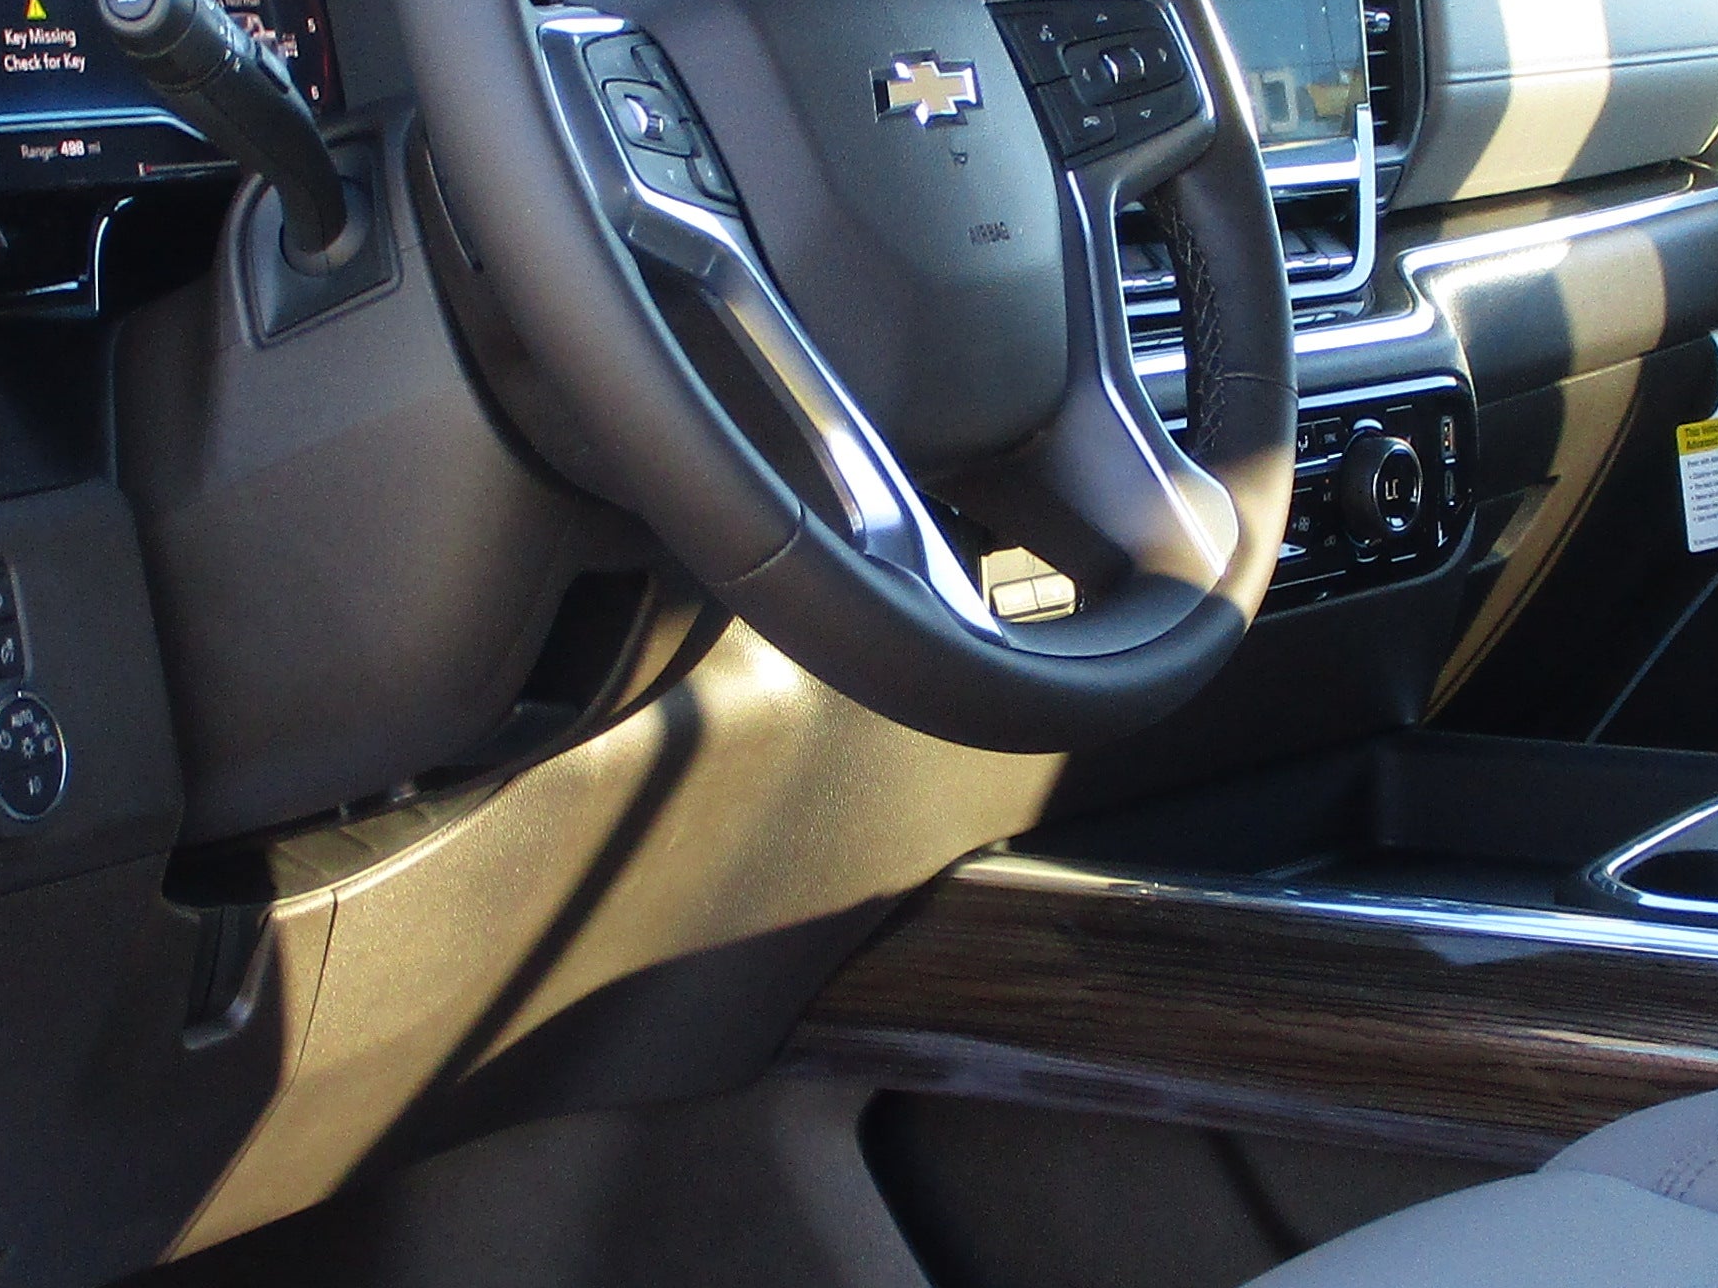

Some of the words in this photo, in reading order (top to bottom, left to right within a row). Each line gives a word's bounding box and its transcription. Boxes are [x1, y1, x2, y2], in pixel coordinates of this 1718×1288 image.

[4, 28, 28, 50] Key
[28, 27, 77, 49] Missing
[4, 52, 42, 72] Check
[43, 52, 61, 70] for
[63, 52, 86, 73] Key
